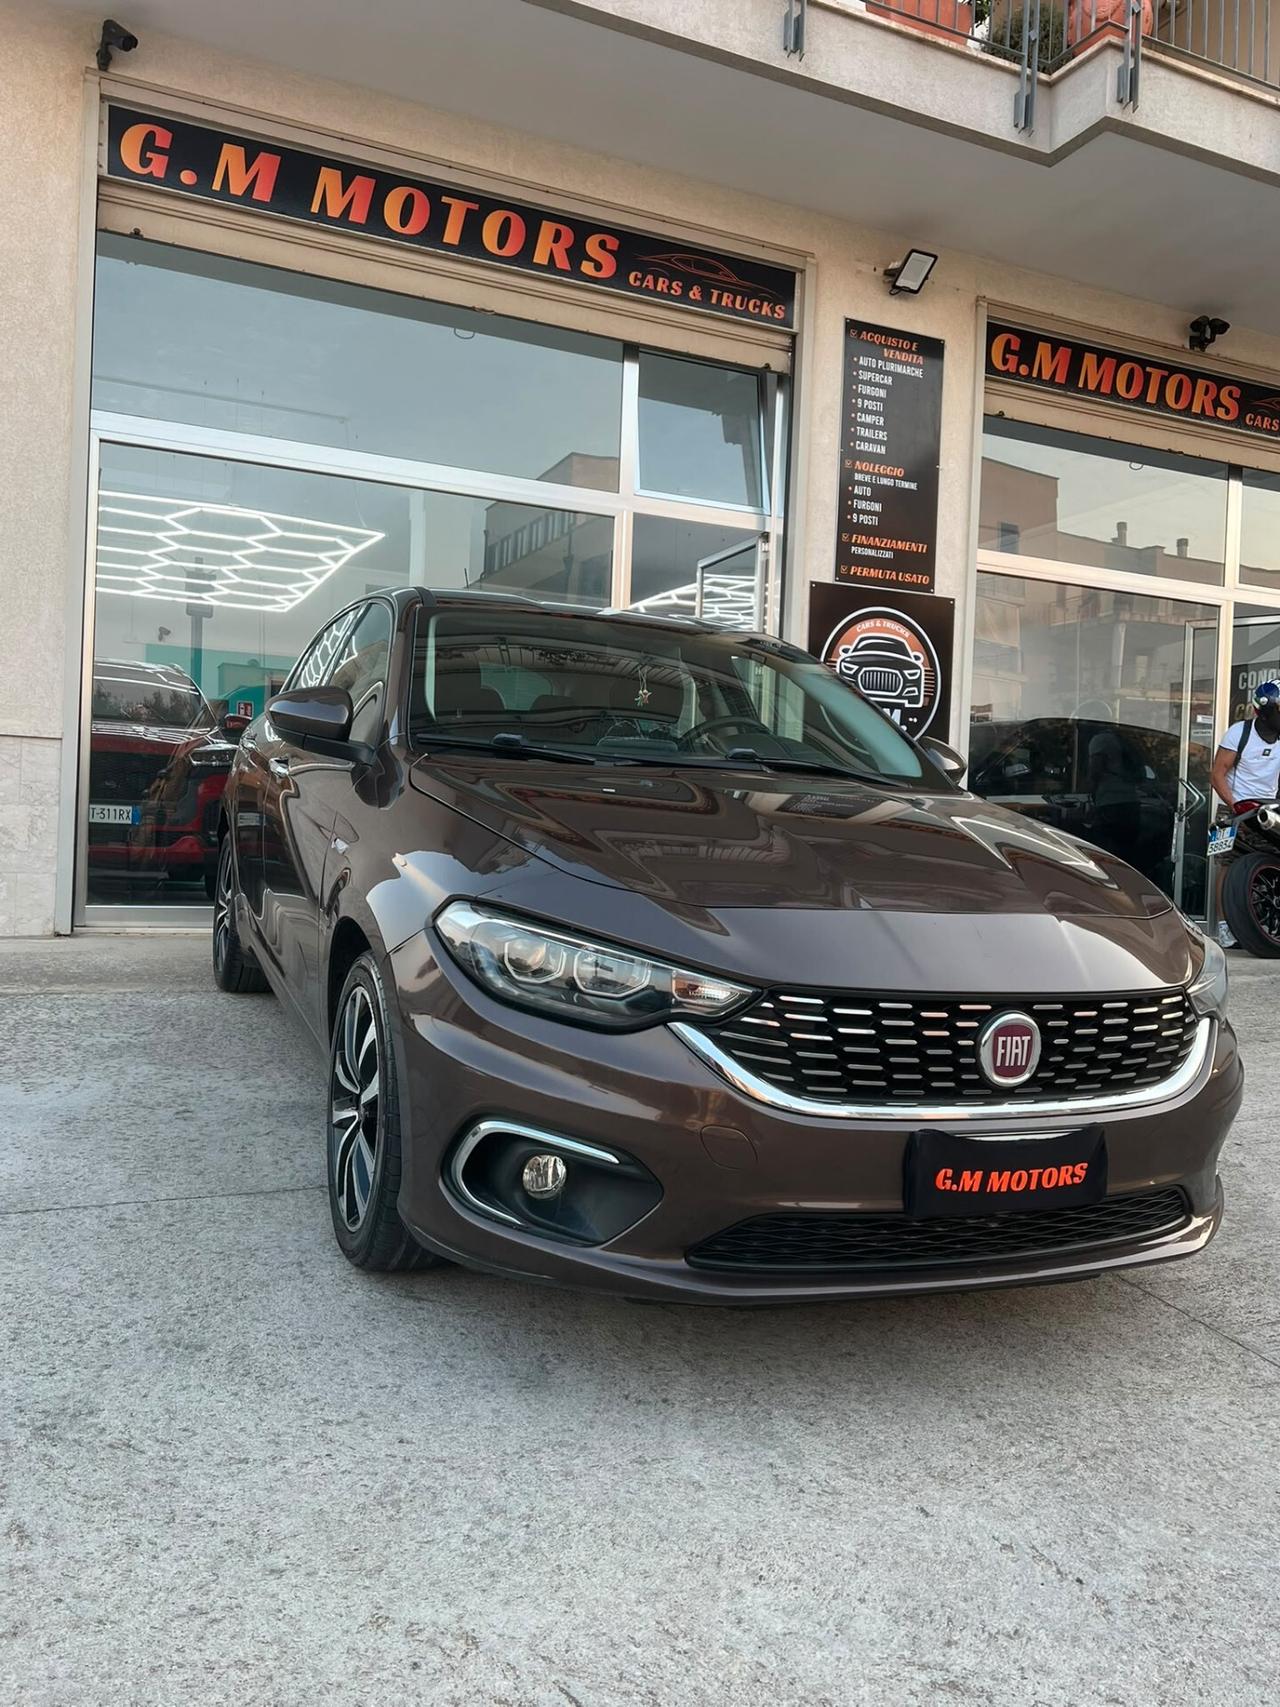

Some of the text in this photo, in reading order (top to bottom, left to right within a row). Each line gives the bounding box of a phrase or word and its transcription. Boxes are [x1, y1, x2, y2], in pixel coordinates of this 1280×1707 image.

[120, 123, 620, 279] G.M MOTORS
[628, 271, 786, 320] CARS & TRUCKS
[860, 331, 918, 351] ACQUISTO E
[883, 348, 924, 365] VENDITA
[859, 356, 924, 378] AUTO PLURIMARCHE
[858, 370, 893, 385] SUPERCAR
[991, 333, 1241, 421] G.M MOTORS
[858, 384, 887, 398] FURGONI
[857, 398, 883, 411] 9 POSTI
[856, 412, 885, 426] CAMPER
[1245, 413, 1280, 431] CARS
[856, 426, 888, 441] TRAILERS
[856, 441, 886, 454] CARAVAN
[854, 460, 904, 477] NOLEGGIO
[854, 473, 918, 491] BREVE E LUNGO TERMINE
[854, 485, 871, 496] AUTO
[853, 499, 882, 512] FURGONI
[852, 513, 879, 526] 9 POSTI
[852, 534, 928, 553] FINANZIAMENTI
[851, 546, 894, 559] PERSONALIZZATI
[850, 566, 930, 584] PERMUTA USATO
[856, 620, 874, 632] CARS
[882, 620, 910, 638] TRUCKS
[996, 1036, 1031, 1067] FIAT
[935, 1162, 1088, 1193] G.M MOTORS
